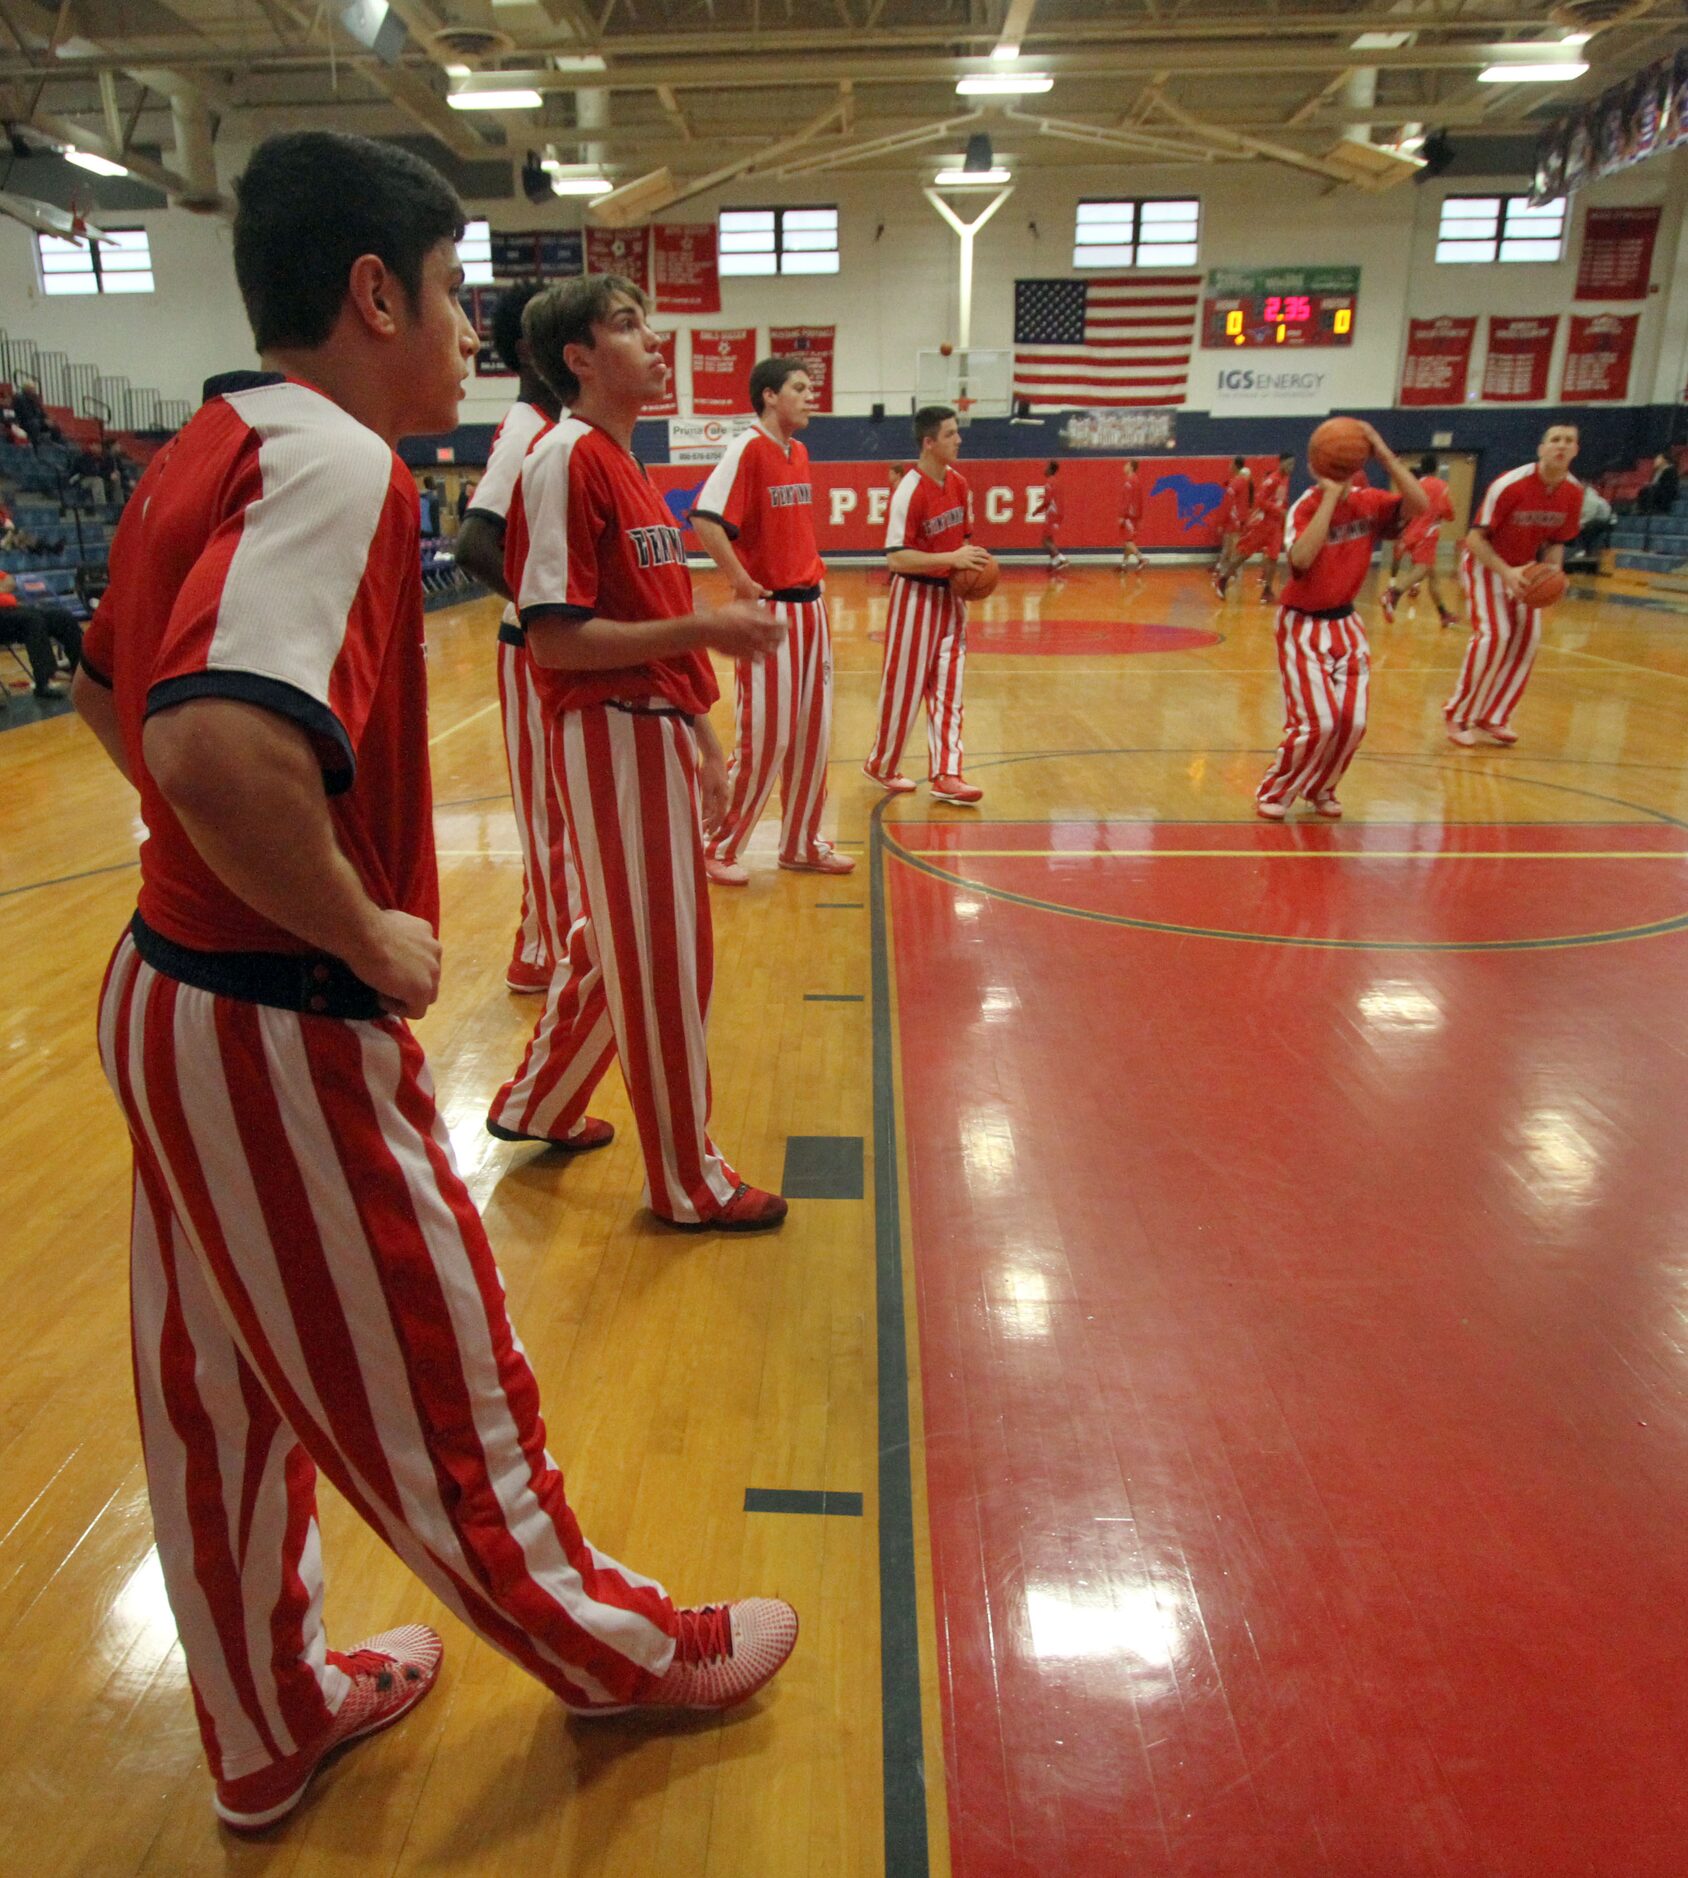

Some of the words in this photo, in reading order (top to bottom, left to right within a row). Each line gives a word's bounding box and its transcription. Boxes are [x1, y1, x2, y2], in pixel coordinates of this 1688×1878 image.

[1226, 310, 1244, 335] 0
[1333, 309, 1351, 334] 0
[1218, 370, 1254, 389] IGS
[1256, 373, 1326, 389] ENERGY
